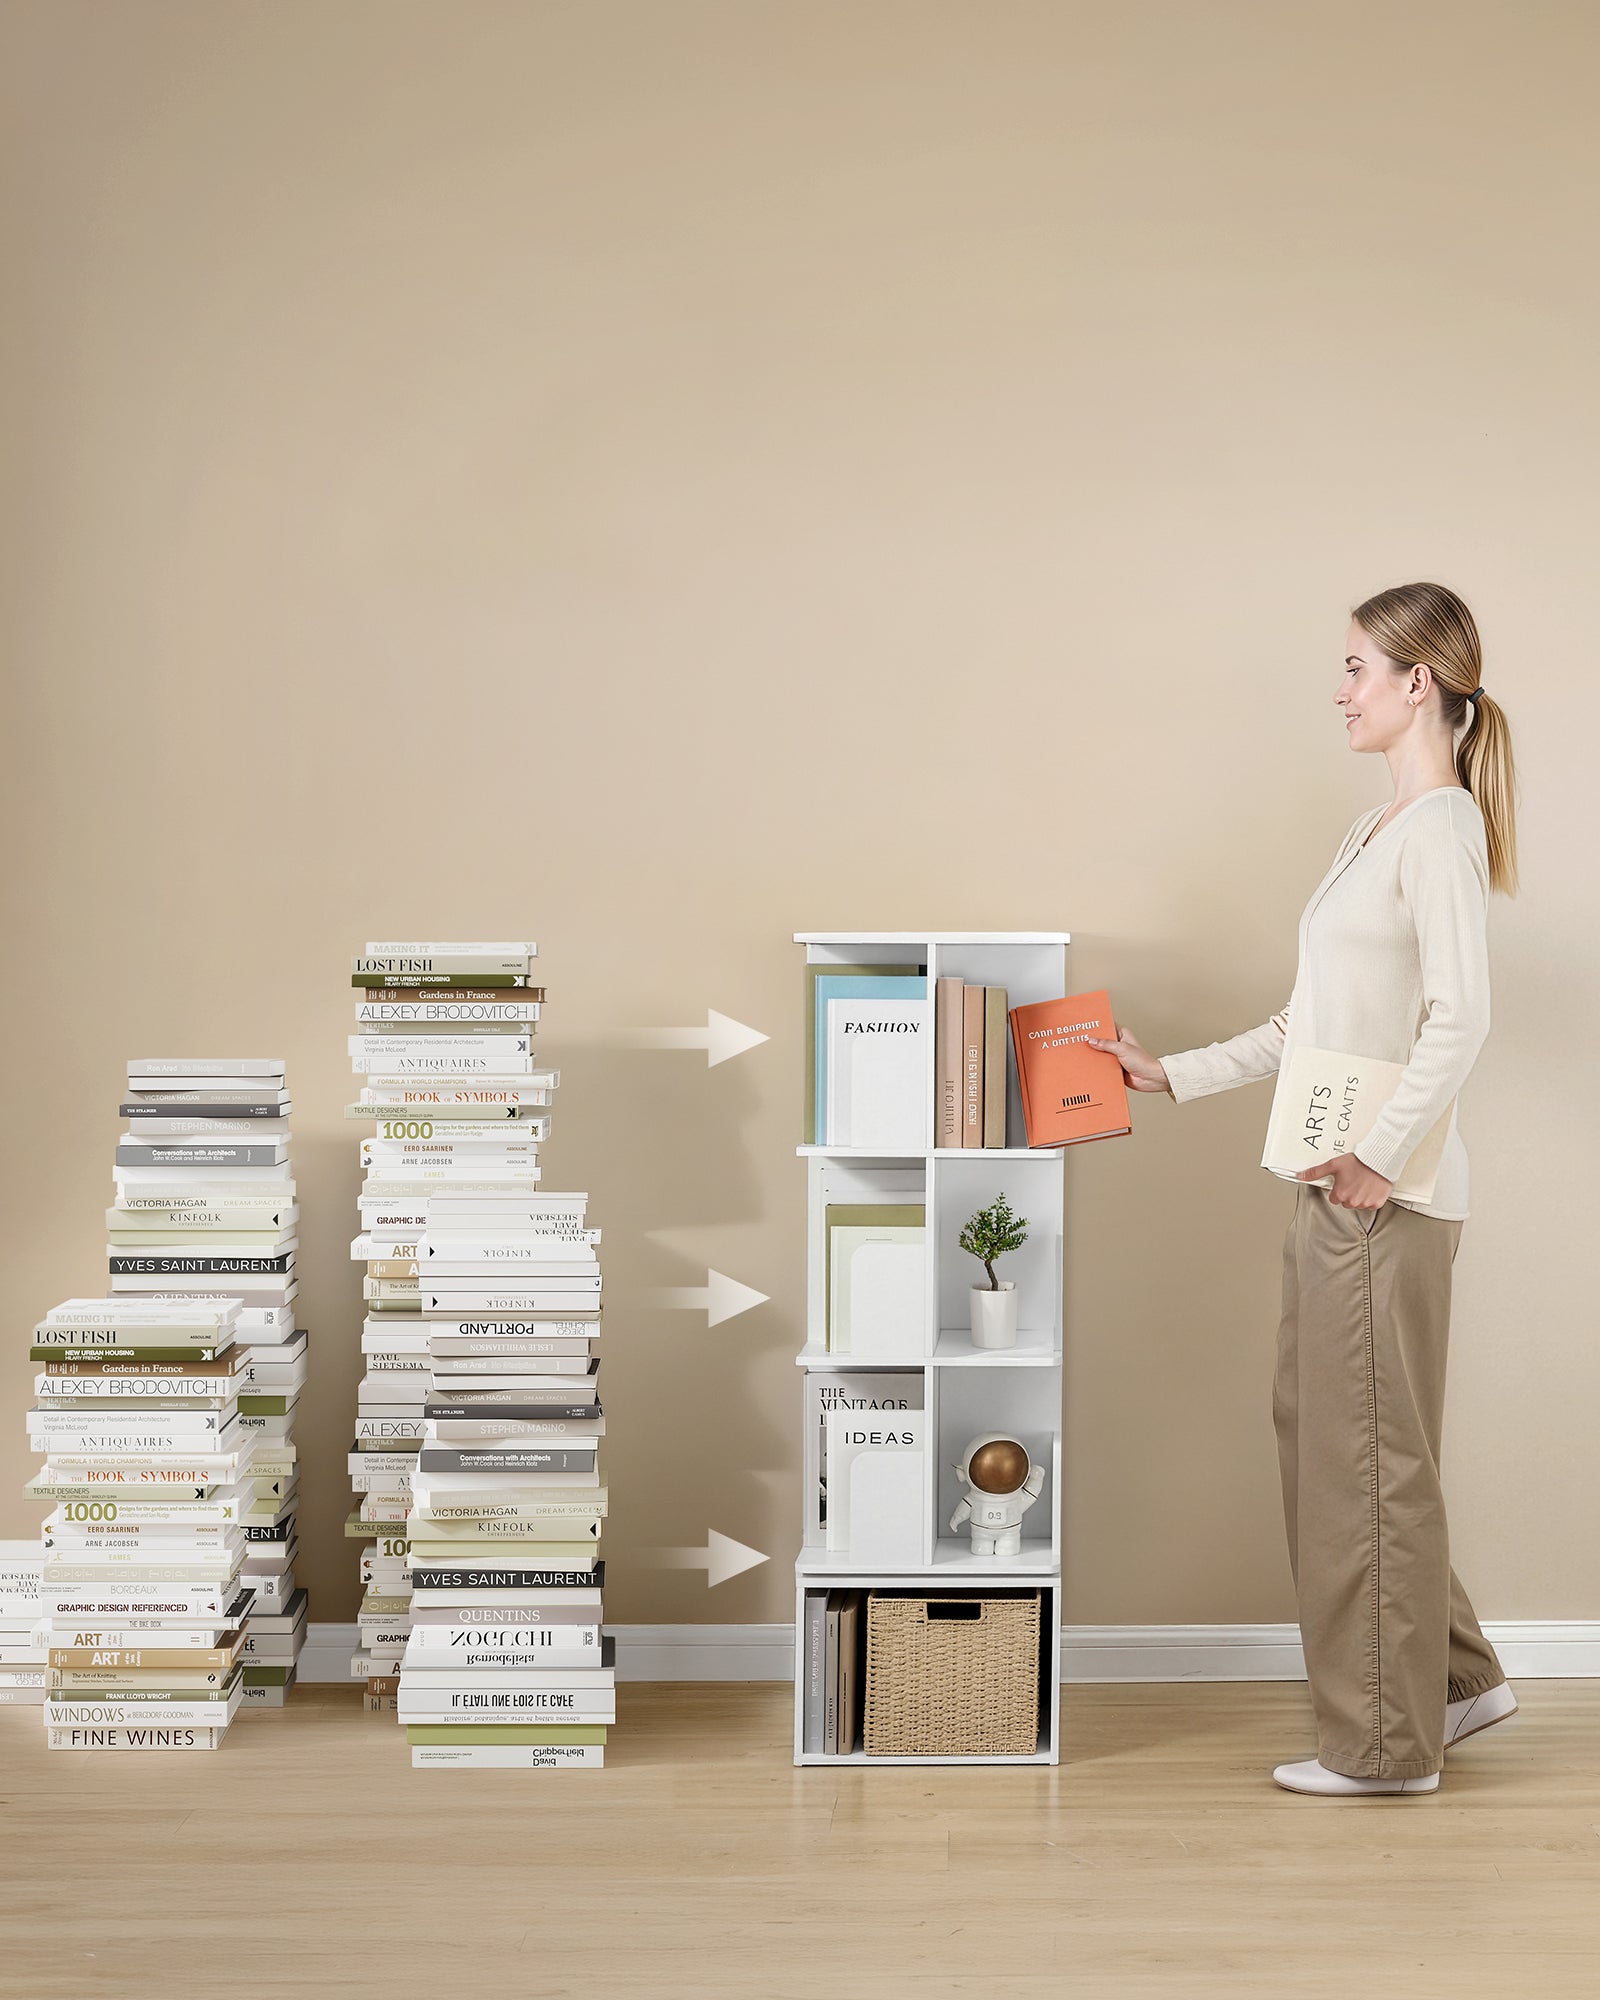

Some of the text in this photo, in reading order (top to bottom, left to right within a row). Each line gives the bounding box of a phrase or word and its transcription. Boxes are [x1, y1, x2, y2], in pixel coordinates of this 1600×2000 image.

[374, 945, 416, 953] MAKING
[419, 945, 430, 953] IT
[357, 959, 432, 972] LOST FISH
[419, 991, 496, 1000] Gardens in France
[360, 1005, 528, 1019] ALEXEY BRODOVITCH
[844, 1023, 920, 1033] FASHION
[398, 1059, 486, 1069] ANTIQUAIRES
[404, 1092, 440, 1103] BOOK
[455, 1092, 519, 1103] SYMBOLS
[1303, 1085, 1332, 1150] ARTS
[171, 1122, 250, 1131] STEPHEN MARINO
[383, 1122, 433, 1139] 1000
[126, 1199, 207, 1208] VICTORIA HAGAN
[170, 1213, 222, 1221] KINFOLK
[376, 1216, 414, 1225] GRAPHIC
[392, 1245, 418, 1258] ART
[117, 1260, 280, 1271] YVES SAINT LAURENT
[486, 1300, 535, 1308] KINFOLK
[55, 1315, 100, 1323] MAKING
[103, 1315, 115, 1323] IT
[459, 1323, 534, 1335] PORTLAND
[36, 1331, 117, 1344] LOST FISH
[102, 1365, 183, 1373] Gardens in France
[39, 1380, 217, 1395] ALEXEY BRODOVITCH
[819, 1388, 845, 1397] THE
[66, 1416, 105, 1424] Contemporary
[44, 1424, 64, 1432] Virginia
[360, 1423, 422, 1437] ALEXEY
[480, 1424, 566, 1434] STEPHEN MARINO
[79, 1437, 173, 1447] ANTIQUAIRES
[845, 1432, 914, 1445] IDEAS
[87, 1471, 125, 1482] BOOK
[140, 1471, 209, 1482] SYMBOLS
[64, 1503, 118, 1521] 1000
[432, 1508, 518, 1517] VICTORIA HAGAN
[478, 1522, 535, 1532] KINFOLK
[420, 1573, 597, 1586] YVES SAINT LAURENT
[110, 1585, 158, 1595] BORDEAUX
[57, 1604, 188, 1612] GRAPHIC DESIGN REFERENCED
[459, 1610, 540, 1624] QUENTINS
[74, 1633, 102, 1646] ART
[91, 1652, 120, 1666] ART
[50, 1708, 125, 1722] WINDOWS
[133, 1711, 162, 1719] BERGDORF
[163, 1711, 194, 1719] GOODMAN
[72, 1730, 117, 1746] FINE
[127, 1730, 195, 1746] WINES
